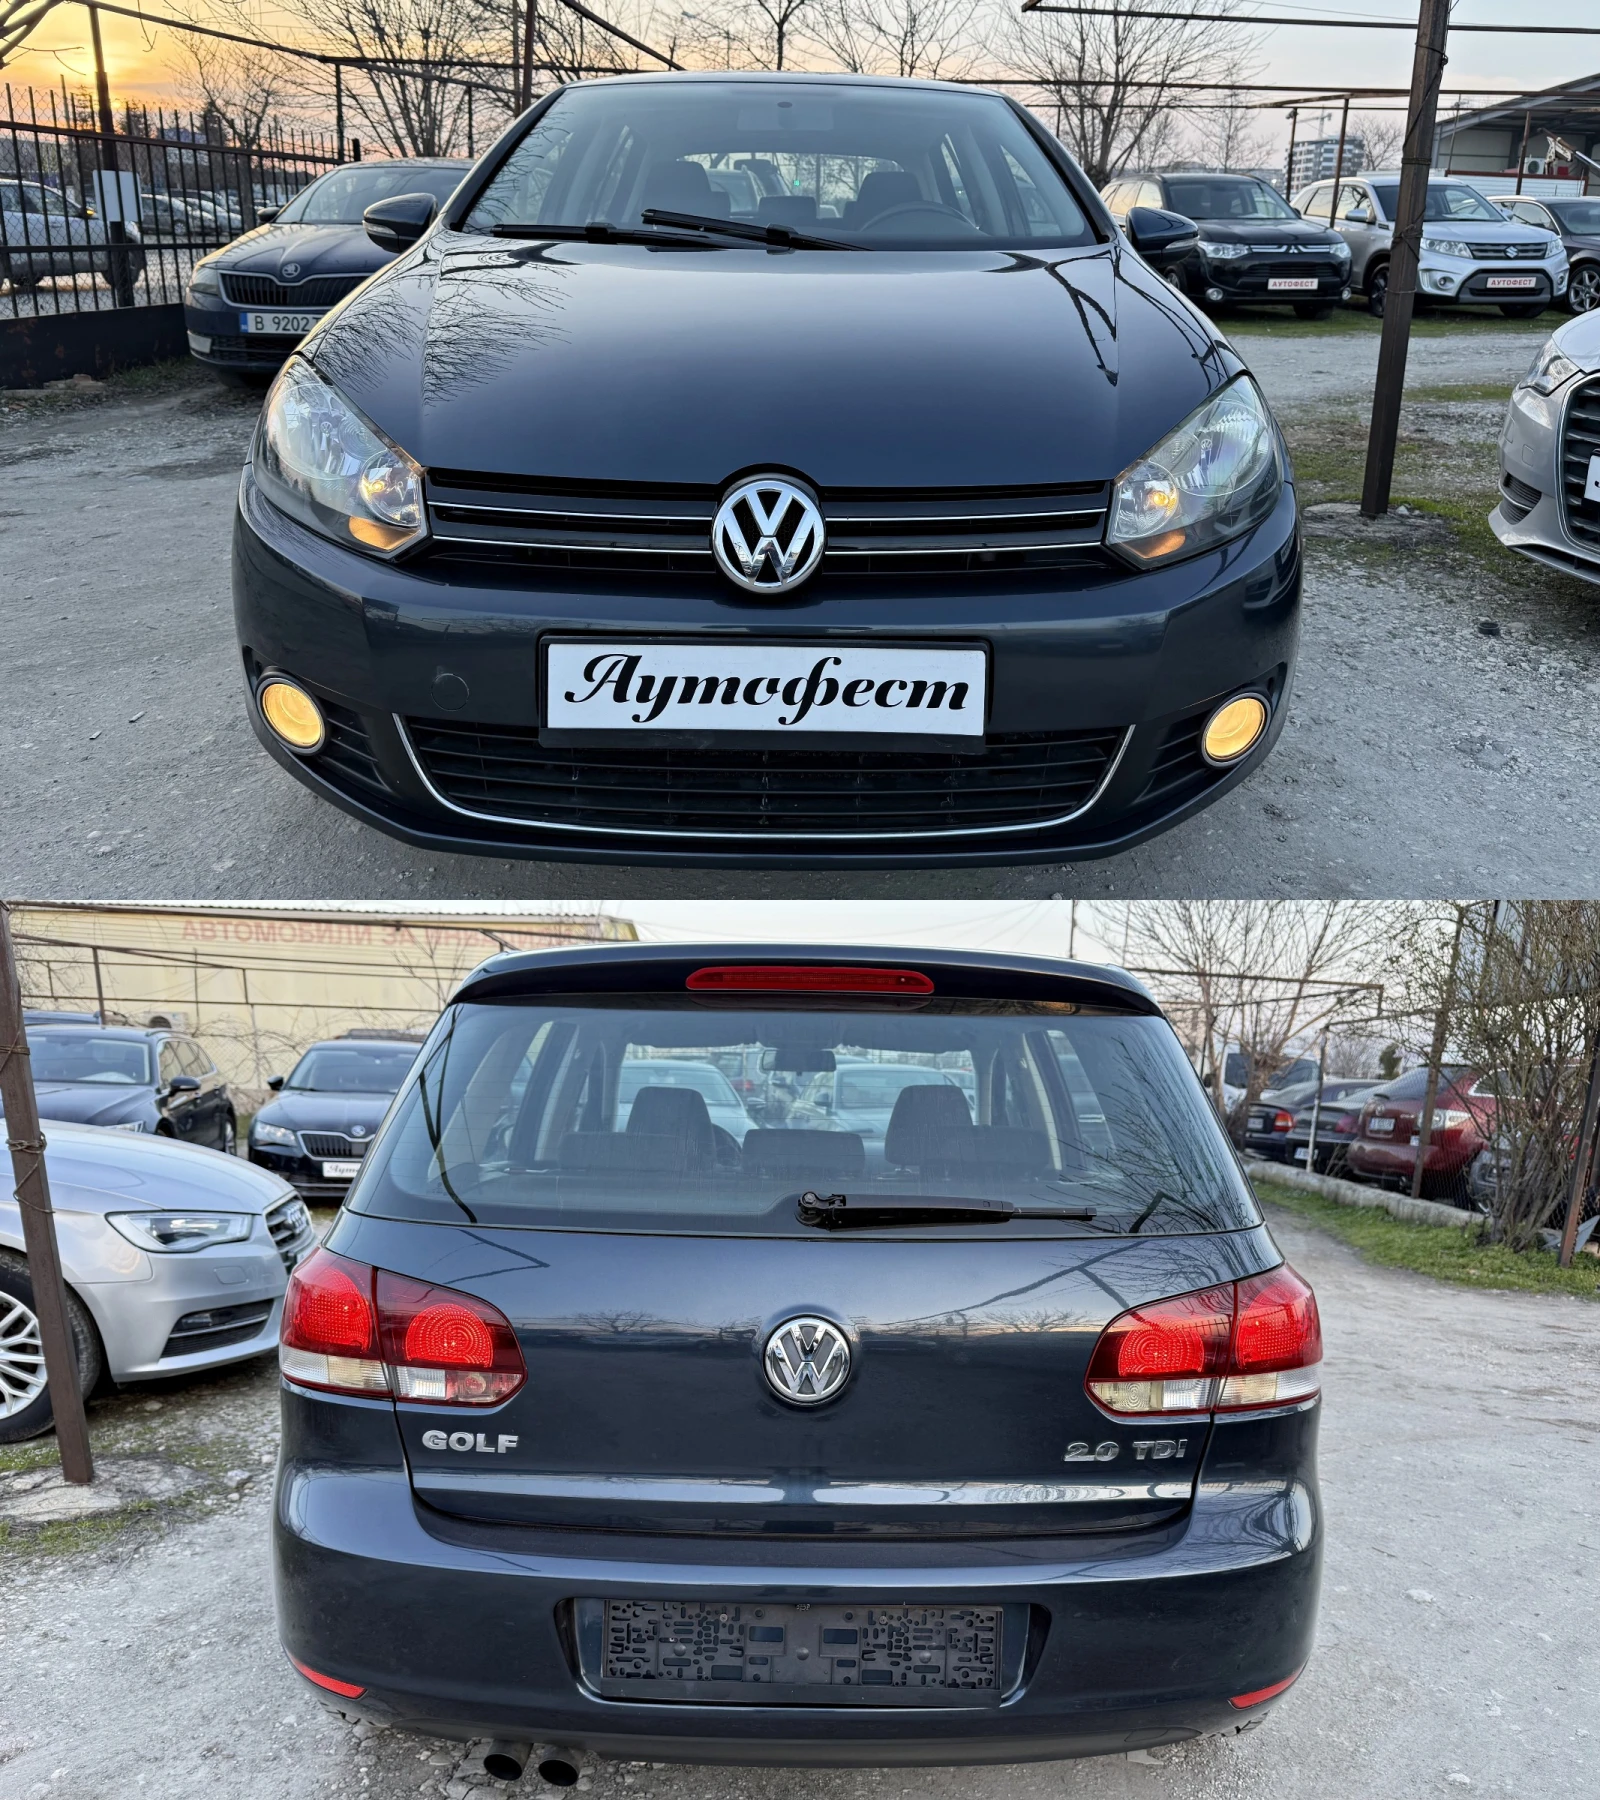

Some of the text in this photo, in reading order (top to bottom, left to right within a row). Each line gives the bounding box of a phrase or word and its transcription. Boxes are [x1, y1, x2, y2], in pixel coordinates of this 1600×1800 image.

[1271, 280, 1315, 288] АУТОФЕСТ
[564, 653, 971, 726] Аутофест
[181, 919, 372, 945] АВТОМОБИЛИ
[421, 1429, 519, 1454] GOLF
[1063, 1438, 1188, 1462] 2.0 TDI
